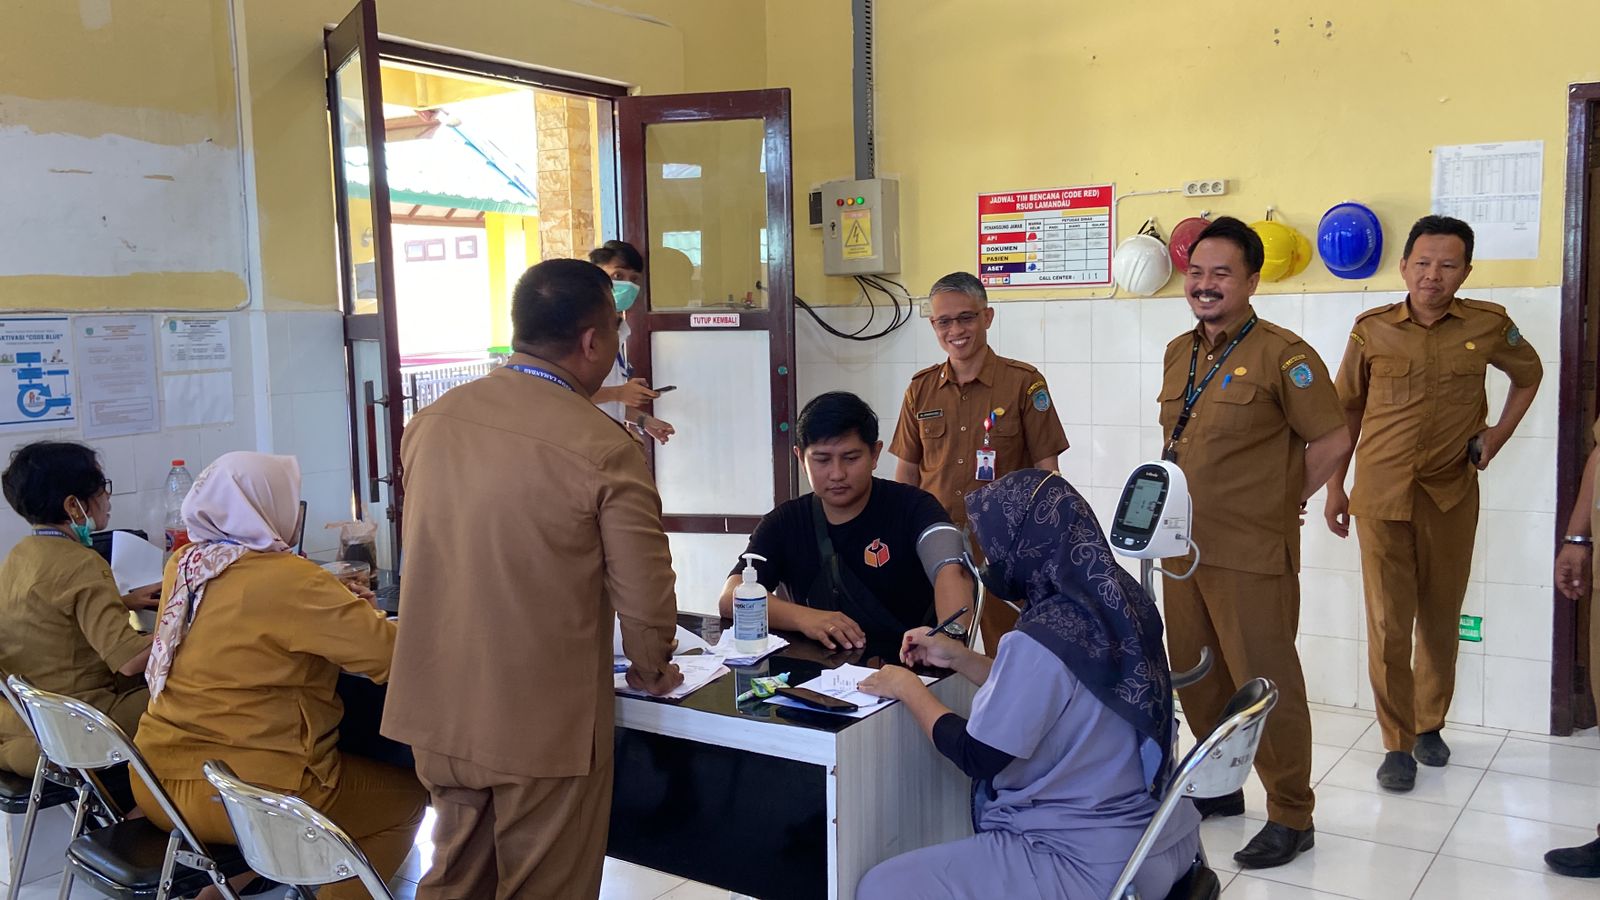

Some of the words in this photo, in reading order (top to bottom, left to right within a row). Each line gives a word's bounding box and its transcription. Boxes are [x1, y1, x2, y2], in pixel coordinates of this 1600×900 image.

[989, 196, 1015, 204] JADWAL
[1016, 194, 1028, 202] TIM
[1029, 192, 1060, 201] BENCANA
[1061, 190, 1082, 199] (CODE
[1083, 189, 1100, 198] RED)
[1034, 200, 1070, 209] LAMANDAU
[693, 316, 712, 324] TUTUP
[713, 316, 737, 324] KEMBALI
